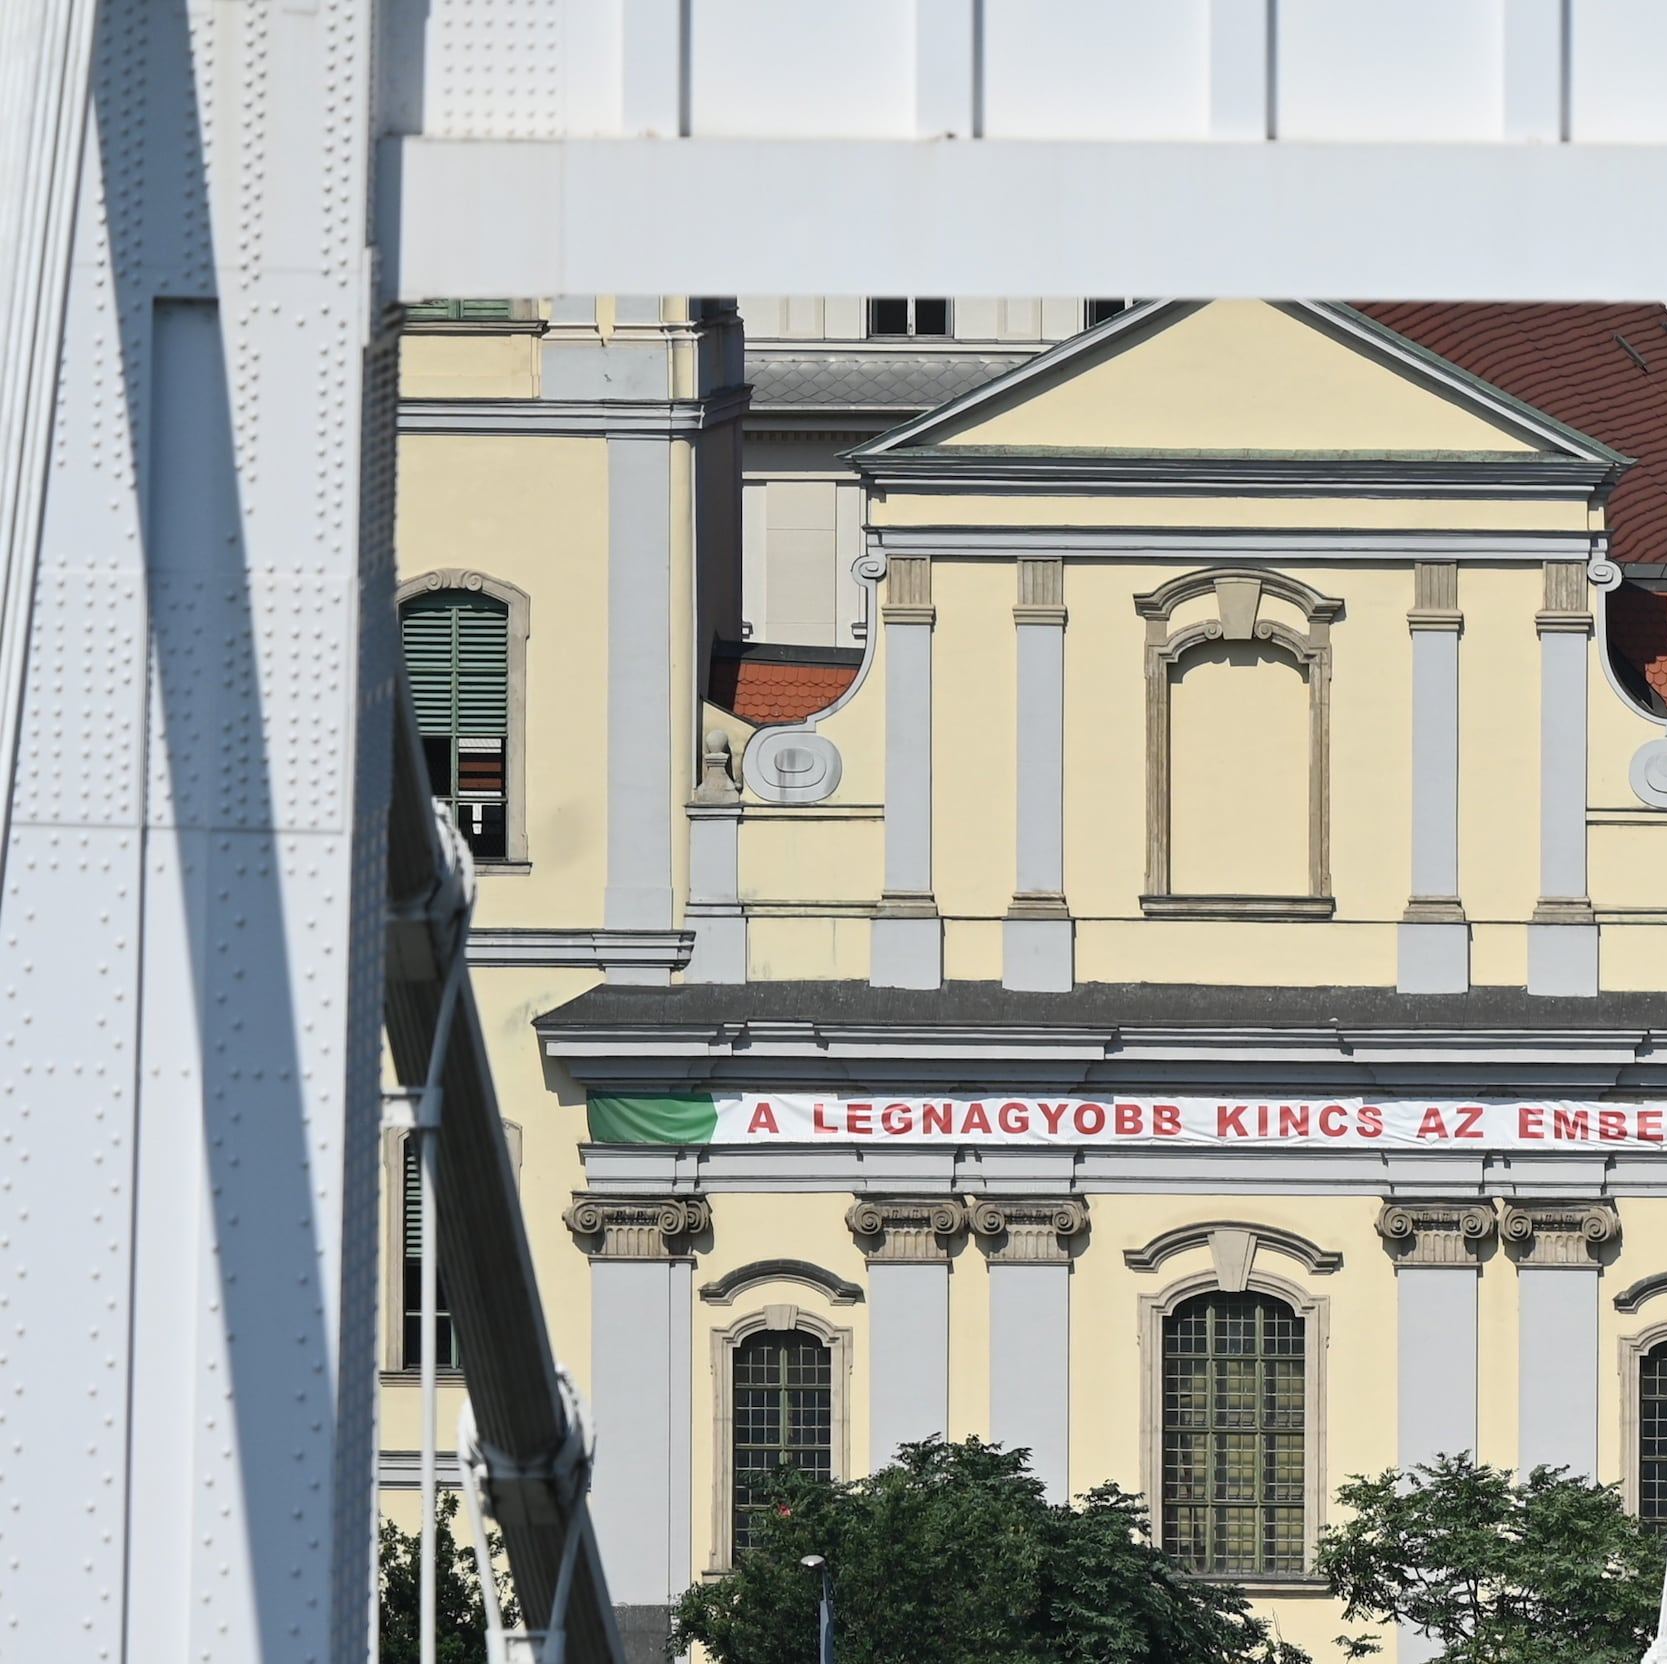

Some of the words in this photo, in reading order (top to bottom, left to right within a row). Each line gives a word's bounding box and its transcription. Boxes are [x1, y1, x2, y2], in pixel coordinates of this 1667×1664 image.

[749, 1102, 779, 1133] A
[814, 1103, 1182, 1135] LEGNAGYOBB
[1217, 1105, 1383, 1137] KINCS
[1419, 1107, 1484, 1138] AZ
